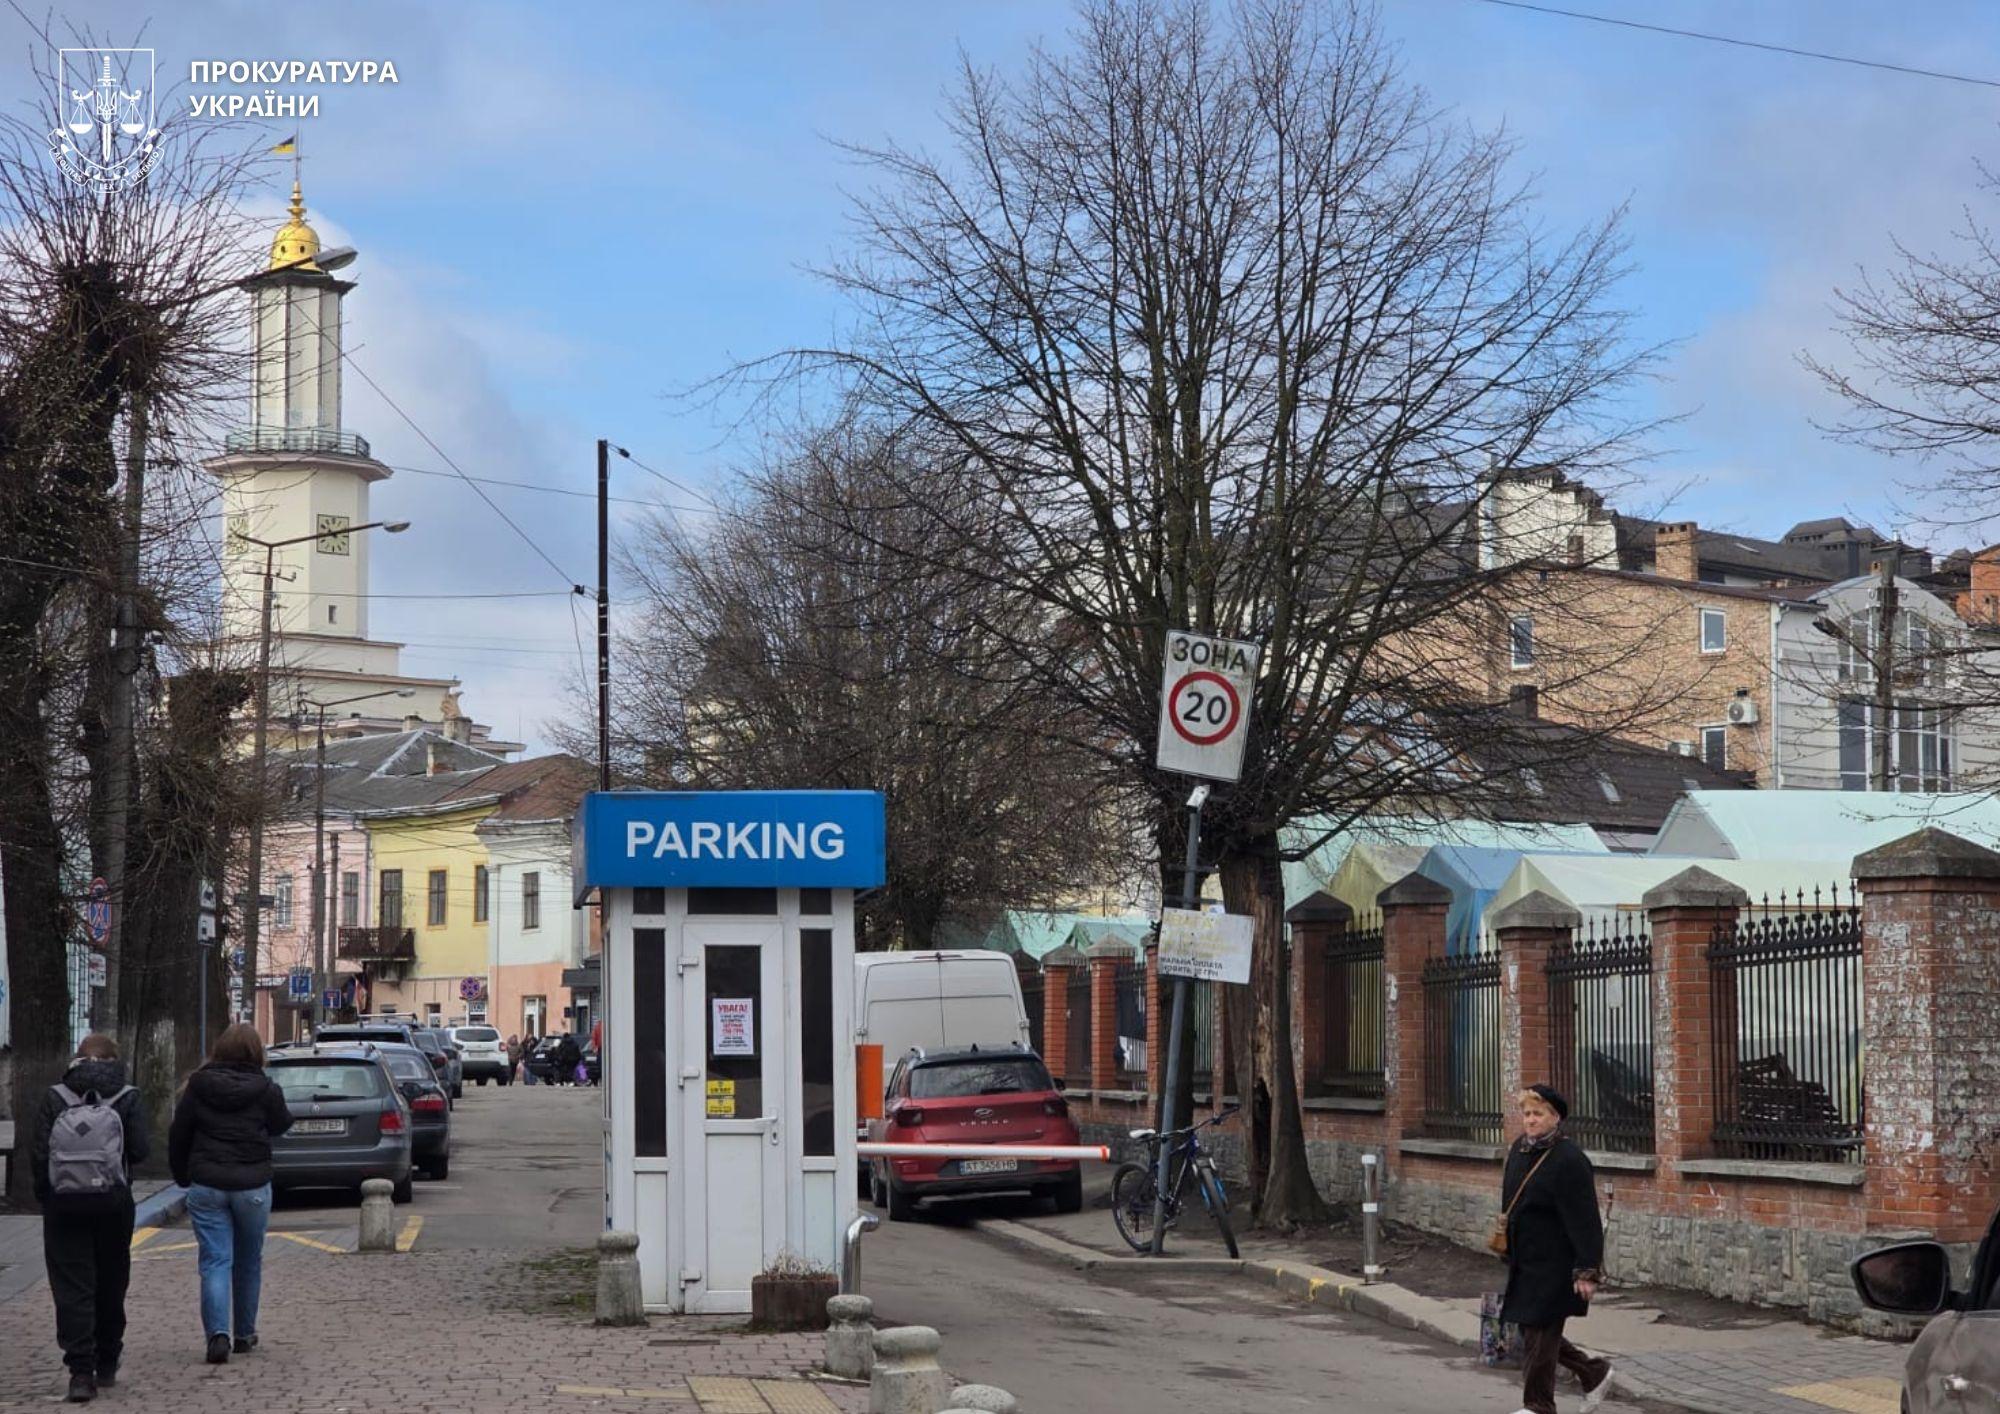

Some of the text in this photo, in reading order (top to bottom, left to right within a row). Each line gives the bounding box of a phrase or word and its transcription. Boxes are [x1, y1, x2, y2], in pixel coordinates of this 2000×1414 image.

[1173, 637, 1247, 673] ЗОНА
[1183, 691, 1227, 725] 20
[626, 821, 845, 860] PARKING
